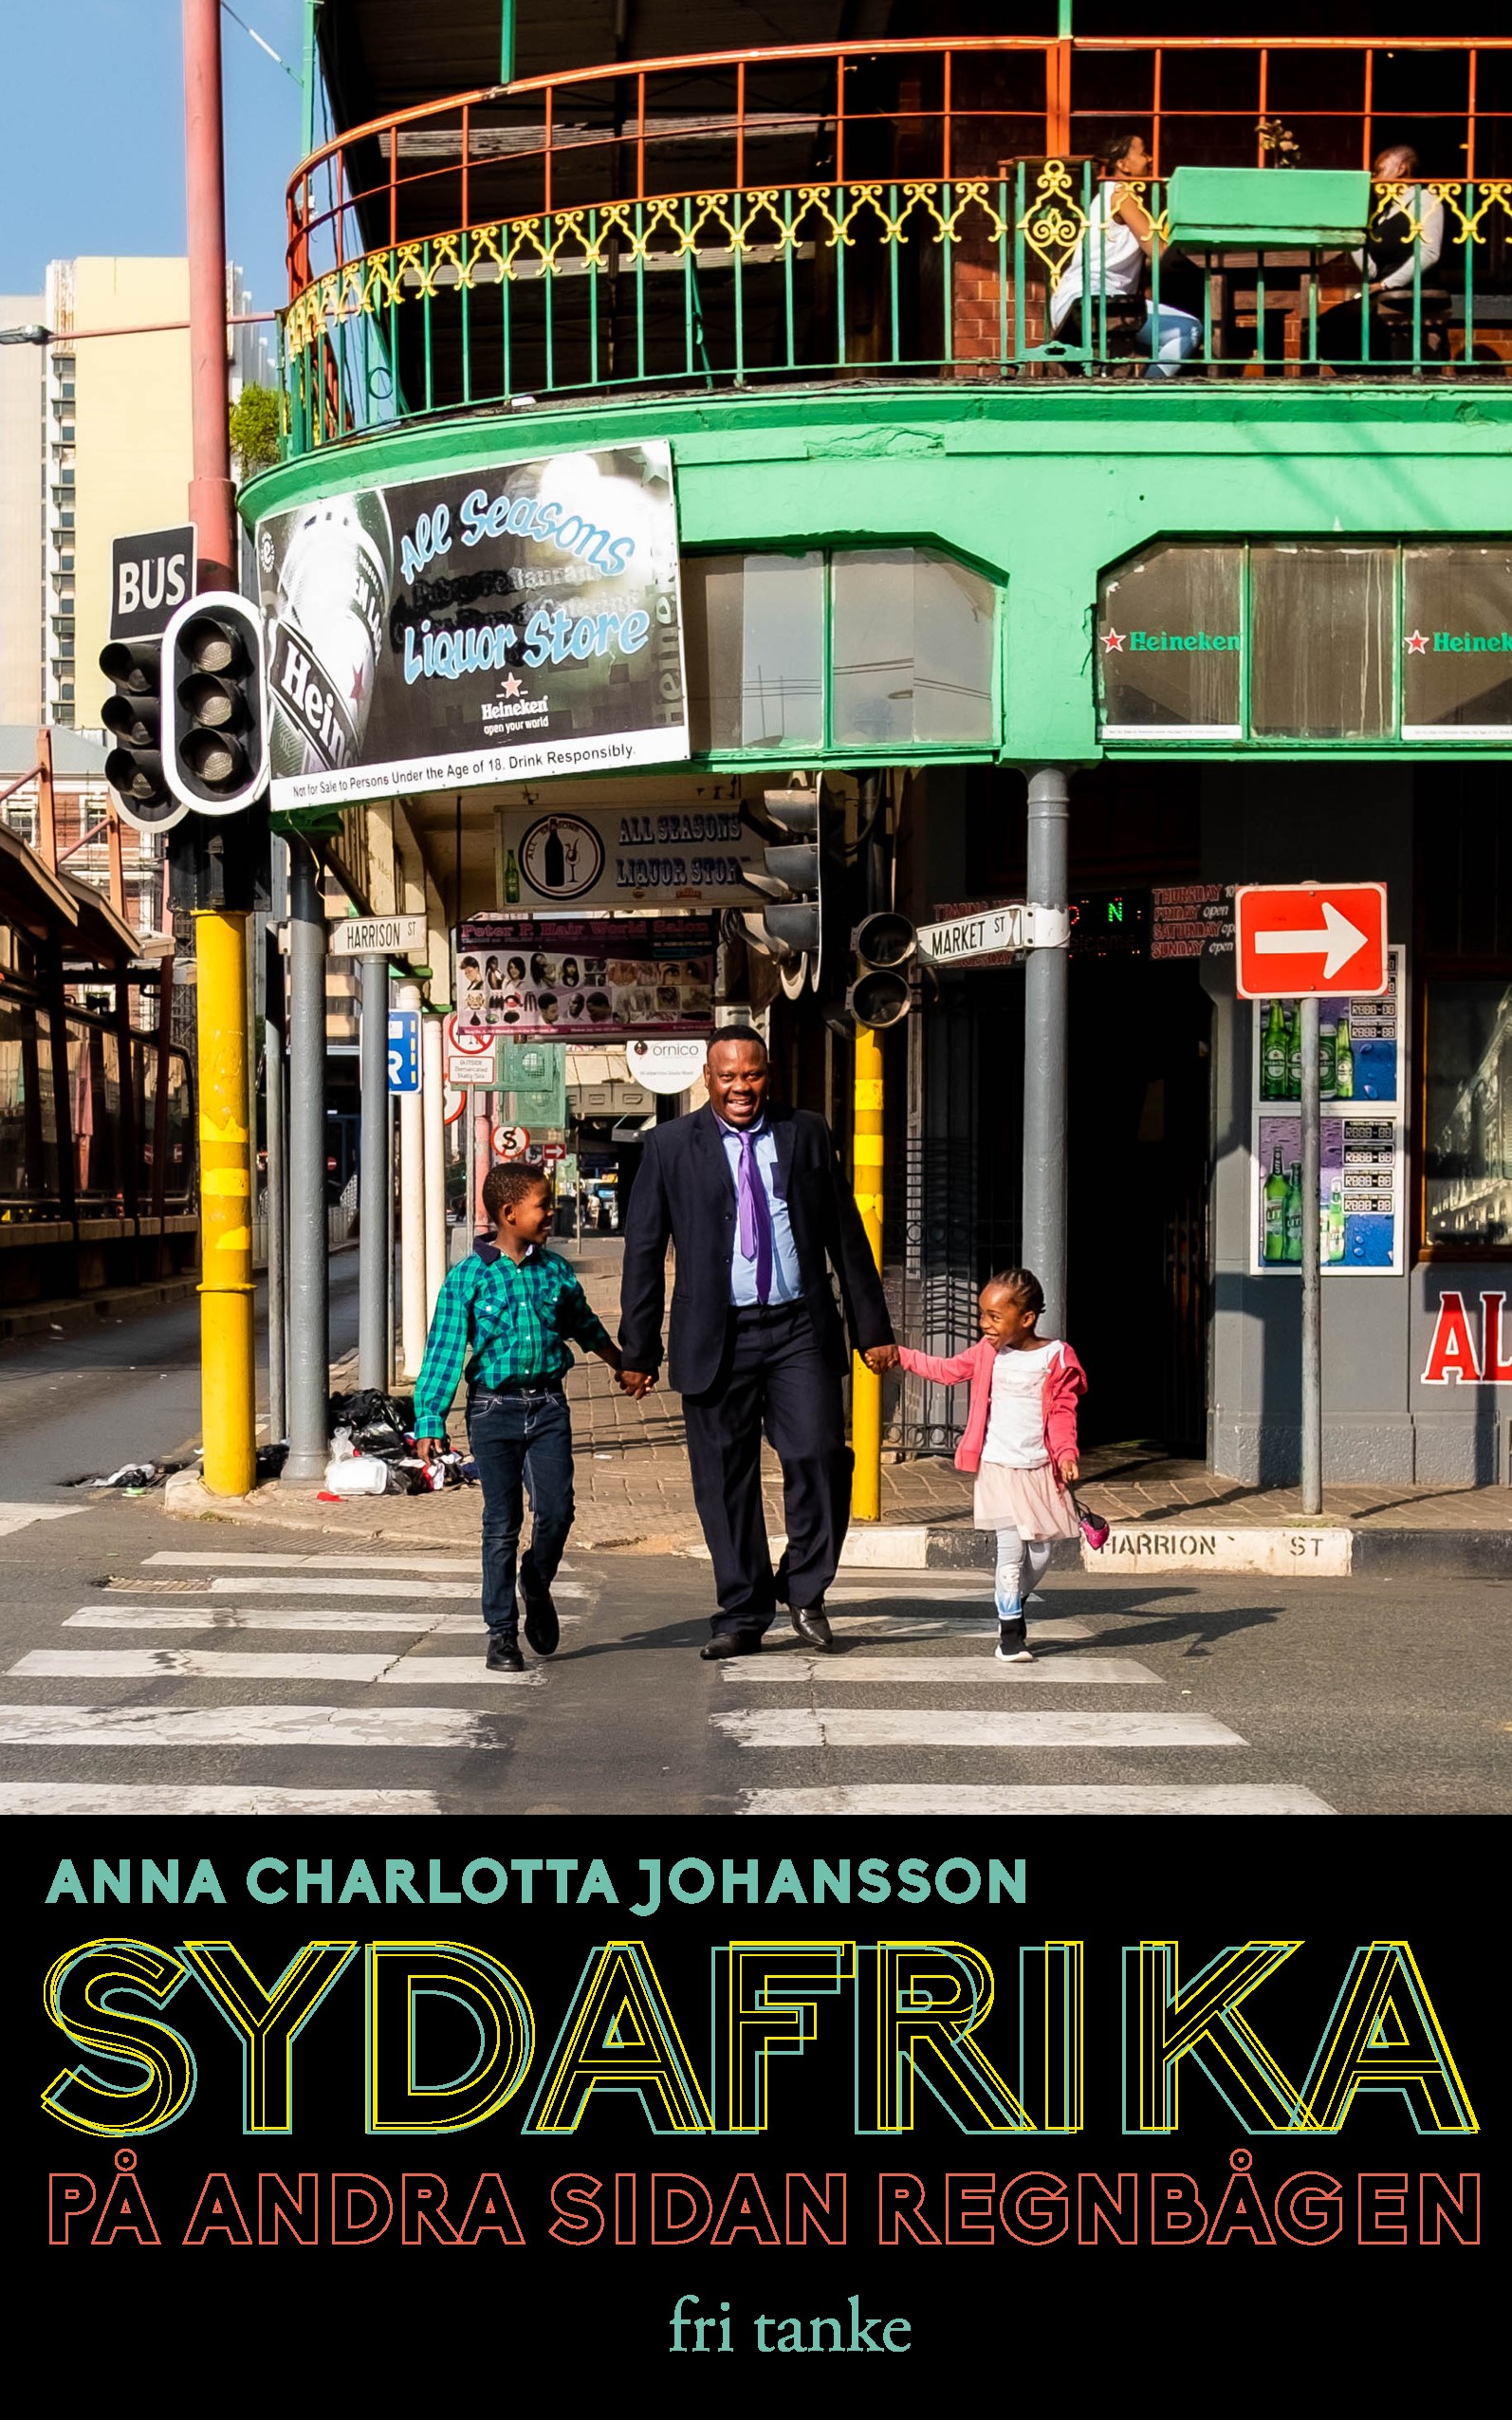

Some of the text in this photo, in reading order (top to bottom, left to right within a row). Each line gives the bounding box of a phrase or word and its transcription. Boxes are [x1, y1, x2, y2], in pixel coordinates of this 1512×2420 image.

[400, 489, 636, 585] All Seasons
[118, 553, 186, 615] BUS
[403, 609, 651, 685] Liquor Store
[1129, 631, 1242, 653] Heineken
[481, 698, 548, 720] Heineken
[483, 715, 549, 736] open your world
[293, 744, 636, 798] Not for Sale to Persons Under the Age of 18. Drink Responsibly.
[618, 812, 743, 845] ALL SEASONS
[616, 856, 749, 888] LIQUOR STOR
[1152, 884, 1223, 905] THURSDAY
[1153, 904, 1229, 921] FRIDAY open
[347, 921, 416, 950] HARRISON ST
[460, 924, 513, 937] Peter
[540, 921, 585, 935] Hair
[590, 920, 646, 934] World
[652, 918, 708, 933] Salon
[932, 916, 1005, 957] MARKET ST
[1152, 920, 1223, 940] SATURDAY
[1151, 940, 1234, 959] SUNDAY open
[653, 1044, 699, 1056] ornico
[1290, 1535, 1324, 1557] ST
